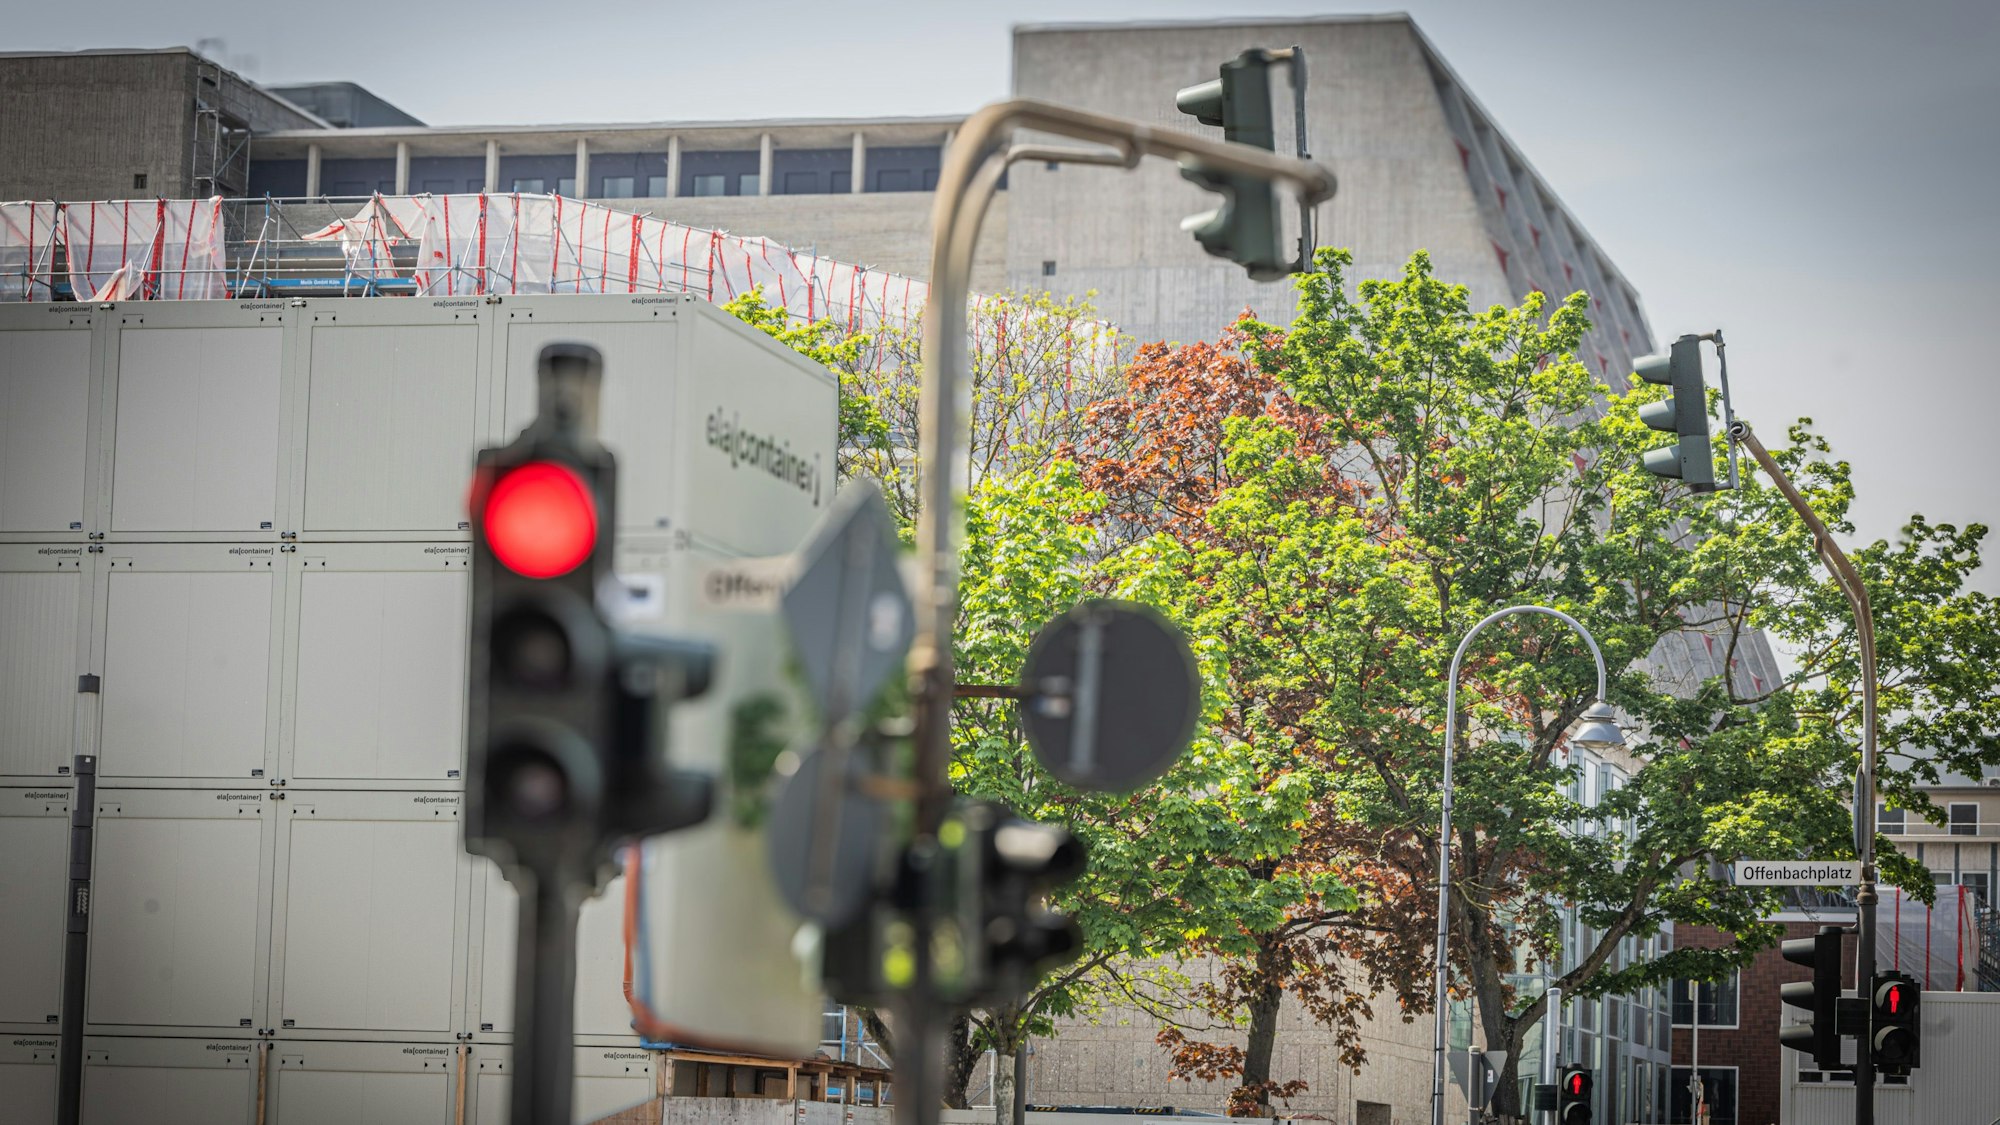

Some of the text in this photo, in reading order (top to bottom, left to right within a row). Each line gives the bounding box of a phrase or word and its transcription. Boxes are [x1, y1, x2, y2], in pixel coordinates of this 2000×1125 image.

[433, 299, 478, 309] ela[container]
[631, 296, 678, 306] ela[container]
[48, 305, 93, 314] ela[container]
[240, 302, 285, 311] ela[container]
[38, 547, 82, 556] ela[container]
[229, 547, 273, 556] ela[container]
[424, 546, 470, 555] ela[container]
[25, 791, 69, 801] ela[container]
[216, 792, 262, 802] ela[container]
[413, 795, 460, 805] ela[container]
[1743, 866, 1852, 882] Offenbachplatz
[13, 1038, 58, 1048] ela[container]
[206, 1043, 252, 1053] ela[container]
[403, 1047, 449, 1057] ela[container]
[604, 1052, 651, 1061] ela[container]
